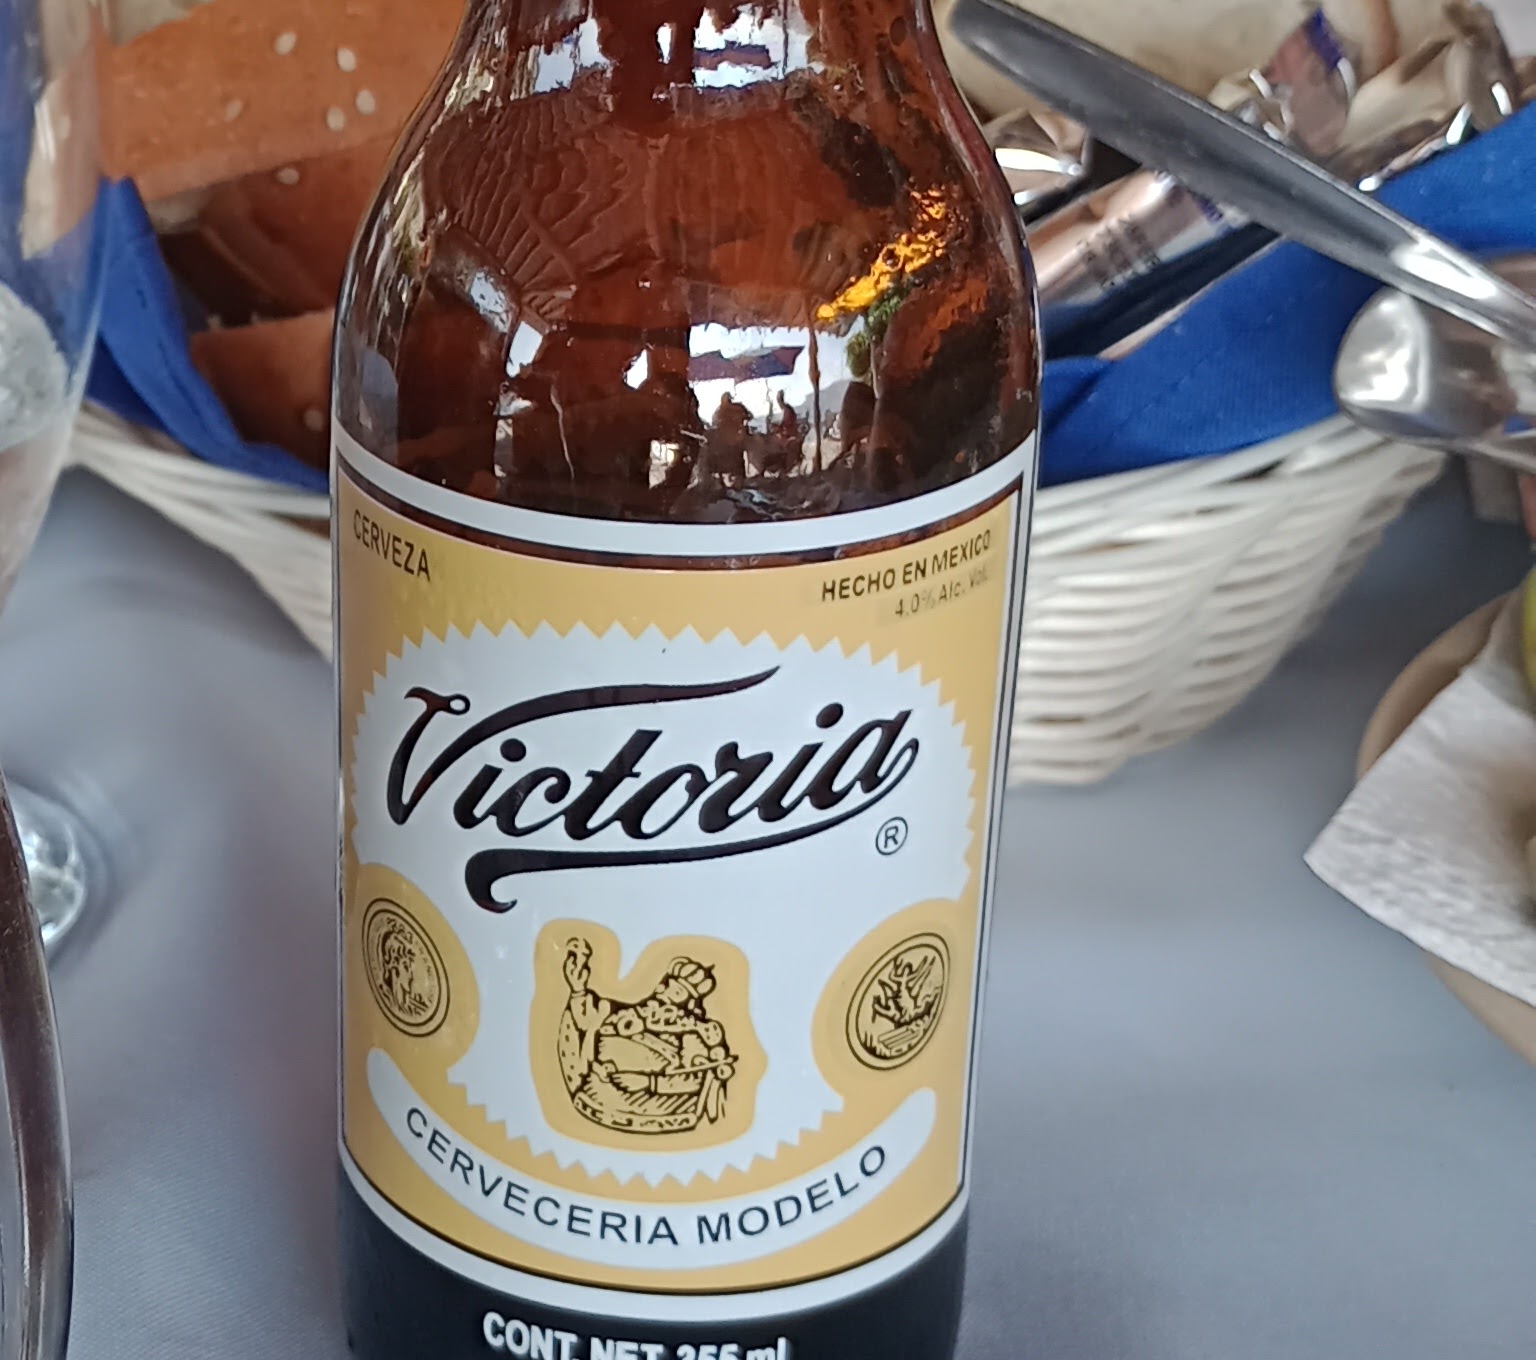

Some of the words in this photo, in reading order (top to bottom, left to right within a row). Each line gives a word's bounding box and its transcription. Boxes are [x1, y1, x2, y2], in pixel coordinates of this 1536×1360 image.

[353, 508, 431, 582] CERVEZA
[821, 567, 896, 602] HECHO
[902, 557, 927, 585] EN
[931, 529, 991, 575] MEXICO
[386, 665, 919, 913] Victoria
[406, 1106, 679, 1246] CERVECERIA
[696, 1145, 886, 1244] MODELO
